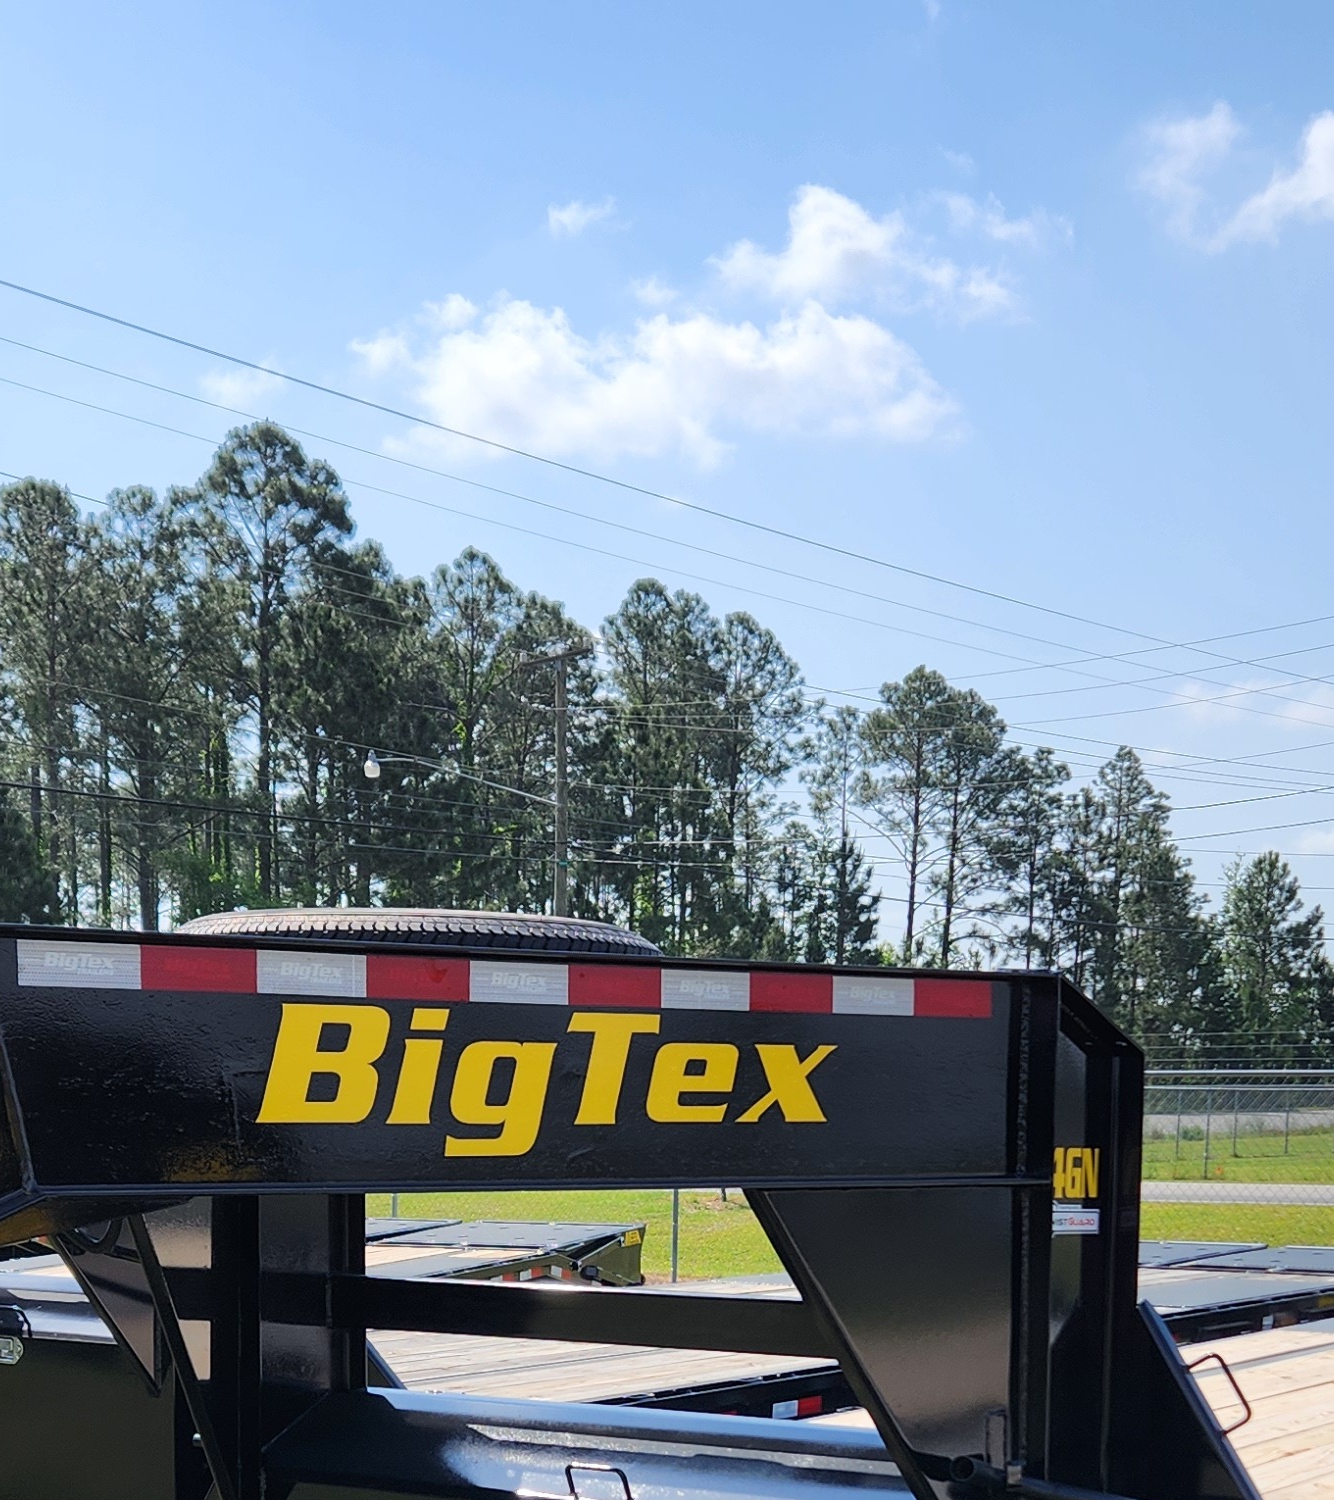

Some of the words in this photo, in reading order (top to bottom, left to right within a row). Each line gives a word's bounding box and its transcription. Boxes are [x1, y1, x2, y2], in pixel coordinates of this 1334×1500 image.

[44, 951, 114, 971] BigTex
[280, 961, 343, 980] BigTex
[491, 971, 548, 989] BigTex
[255, 1003, 839, 1157] BigTex
